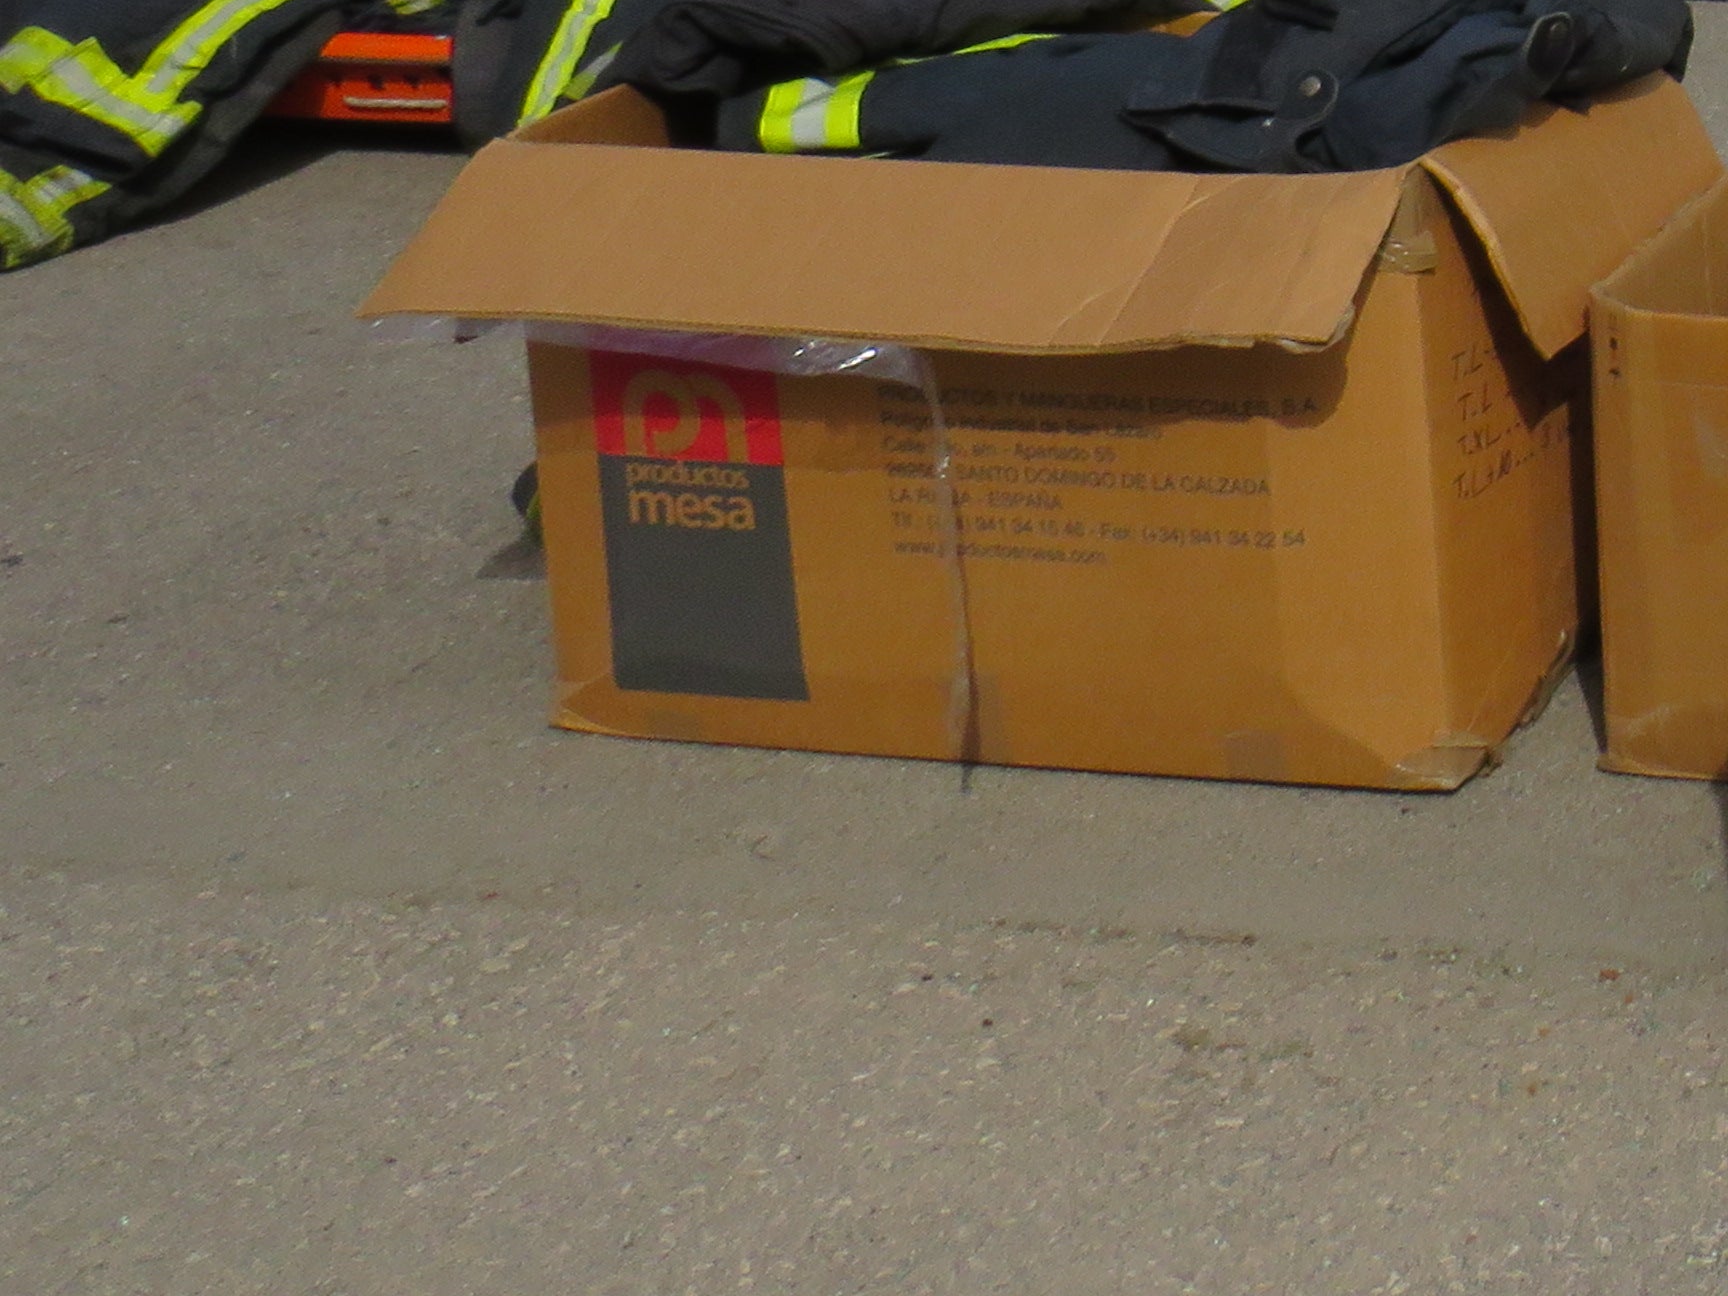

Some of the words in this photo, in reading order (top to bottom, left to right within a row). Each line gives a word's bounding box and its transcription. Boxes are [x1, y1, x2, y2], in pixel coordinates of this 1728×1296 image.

[626, 460, 750, 489] productos
[1120, 471, 1146, 491] DE
[1150, 473, 1176, 493] LA
[1179, 474, 1271, 498] CALZADA
[628, 489, 757, 531] mesa
